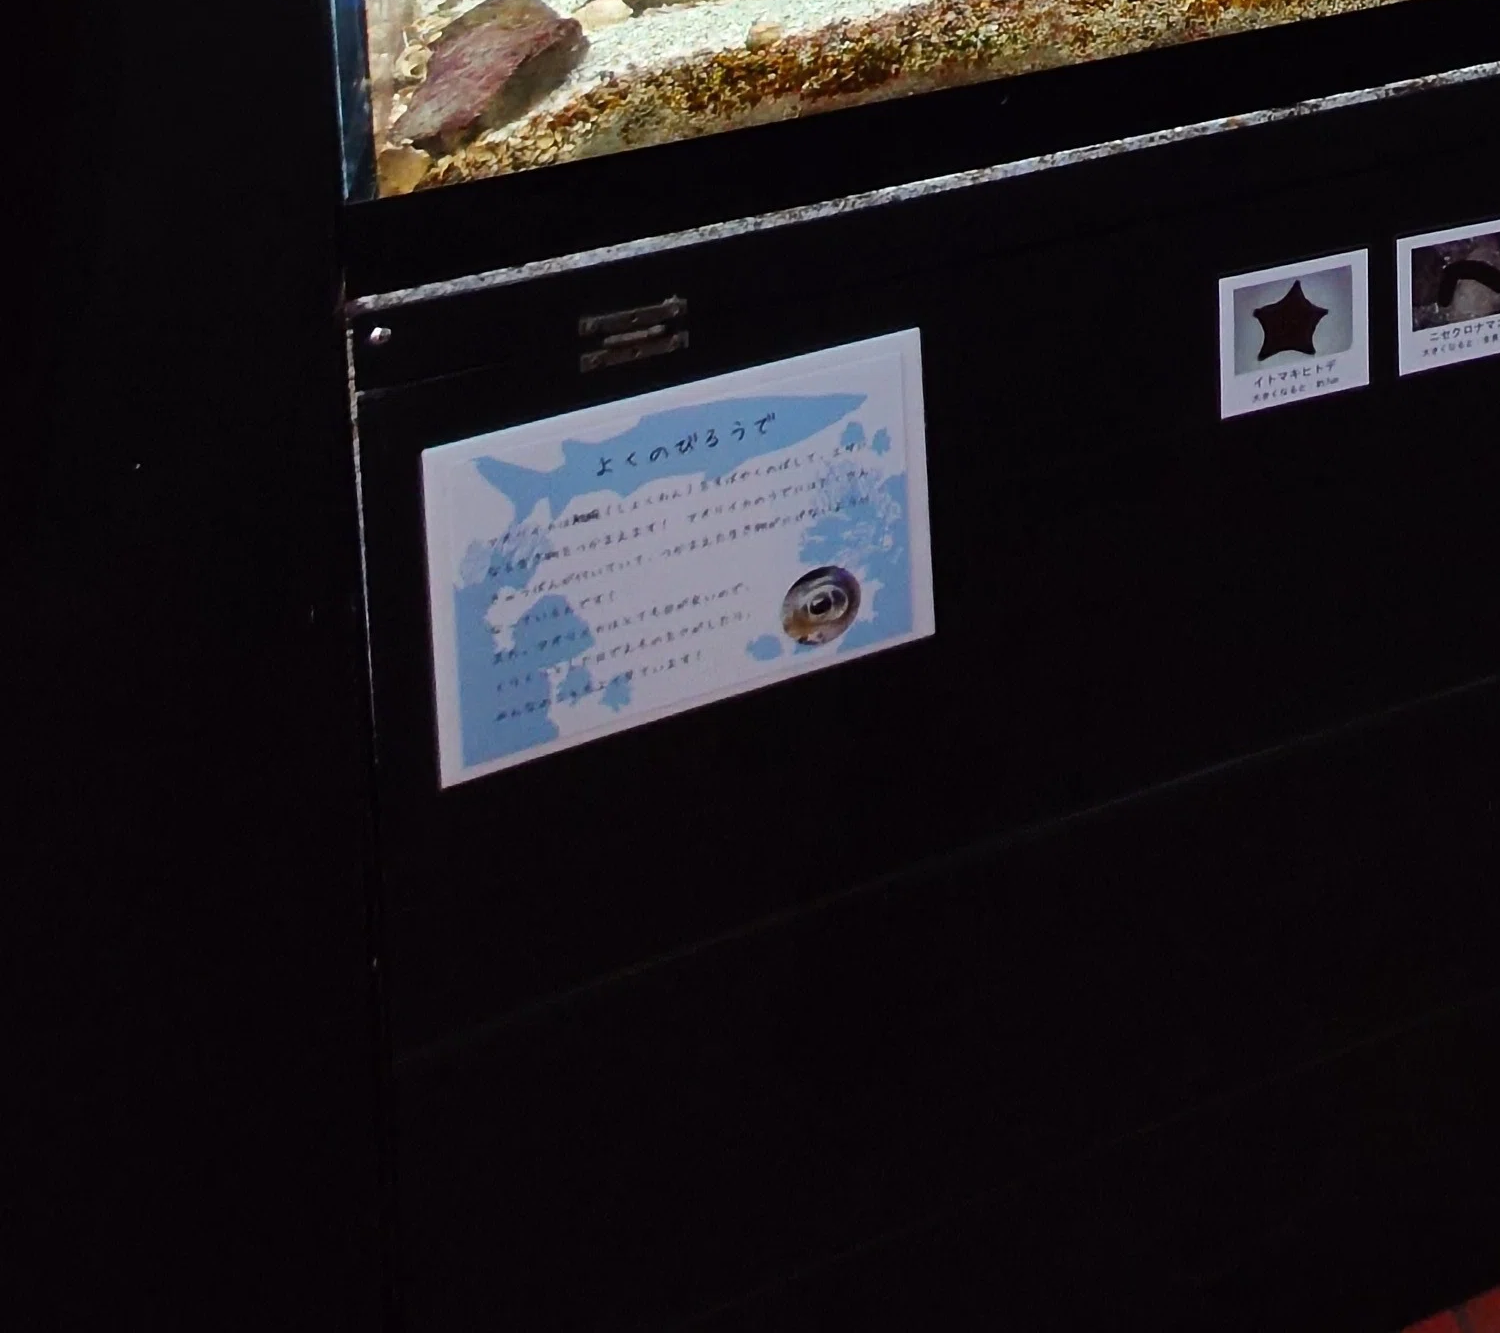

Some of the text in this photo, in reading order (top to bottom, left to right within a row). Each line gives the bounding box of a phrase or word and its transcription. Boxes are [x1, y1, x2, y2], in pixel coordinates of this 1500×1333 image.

[1254, 358, 1337, 389] イトマキヒトデ
[596, 412, 776, 477] よくのびるうで
